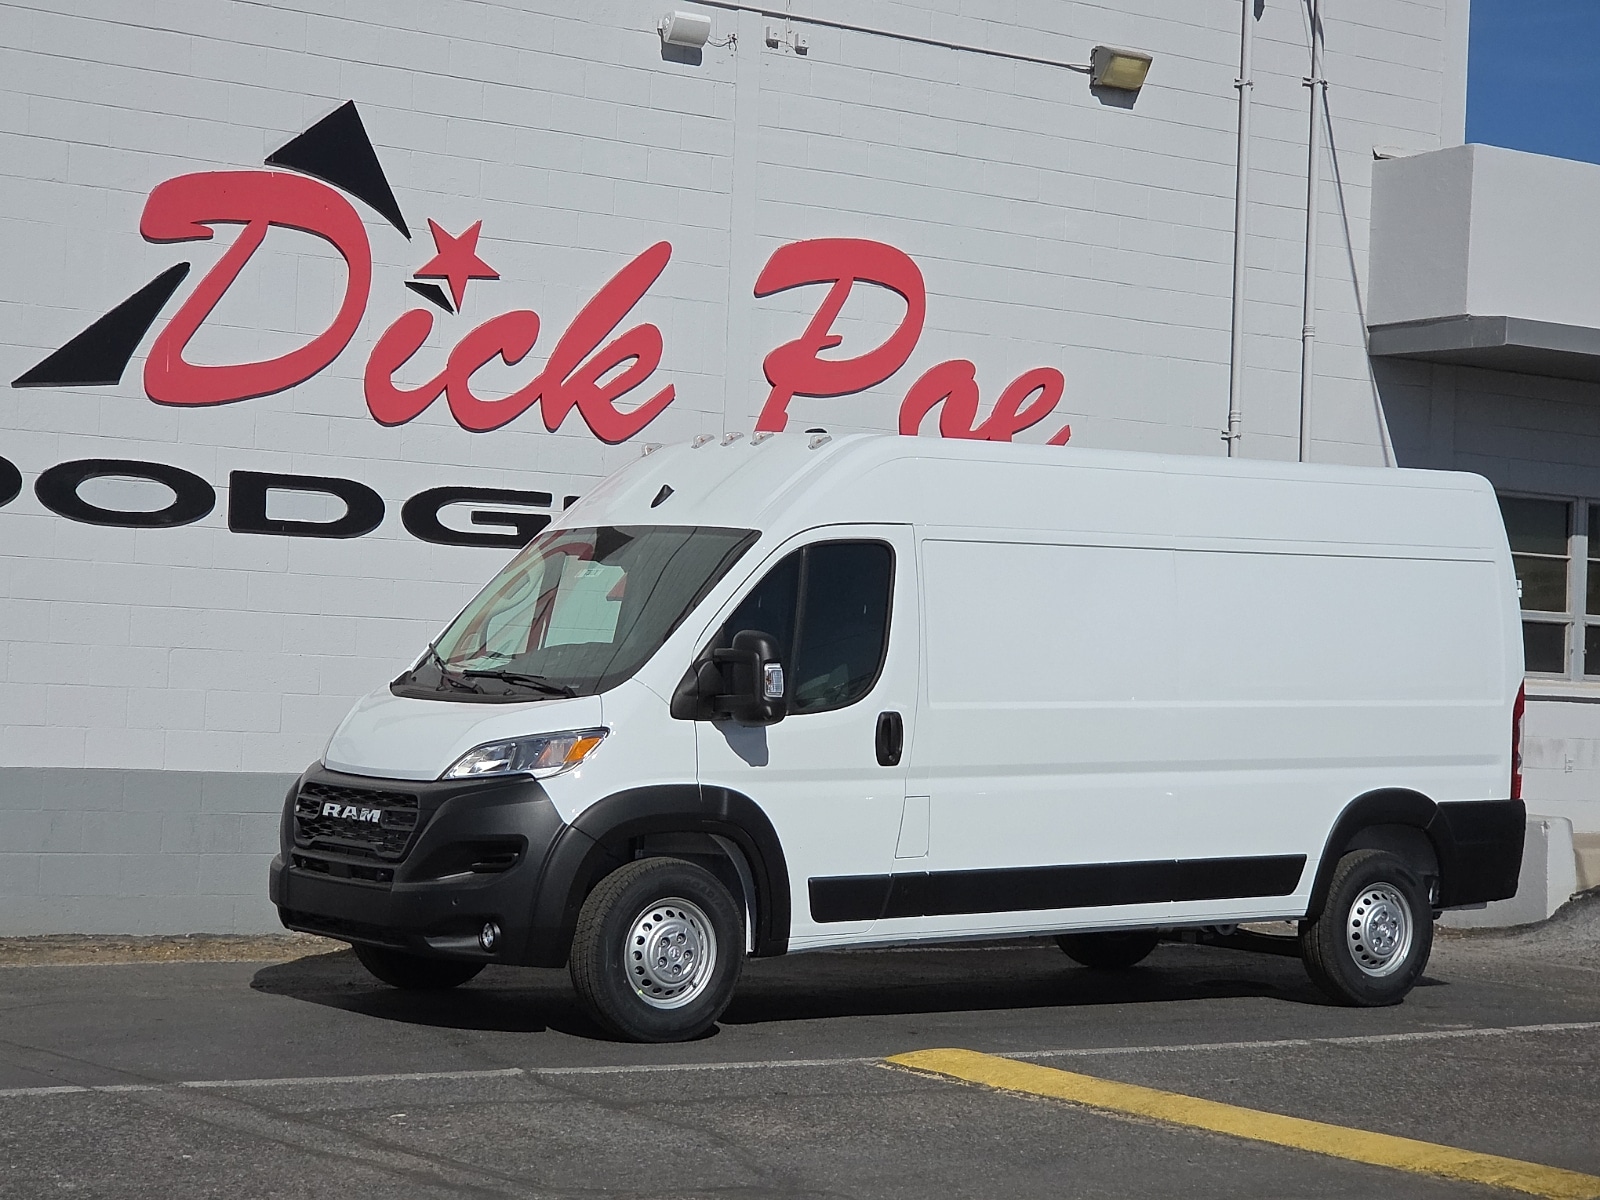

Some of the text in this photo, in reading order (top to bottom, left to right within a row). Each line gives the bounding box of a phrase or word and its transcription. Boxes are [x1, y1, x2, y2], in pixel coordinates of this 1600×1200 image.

[140, 170, 675, 445] Dick
[0, 456, 581, 549] ODG
[322, 802, 381, 823] RAM
